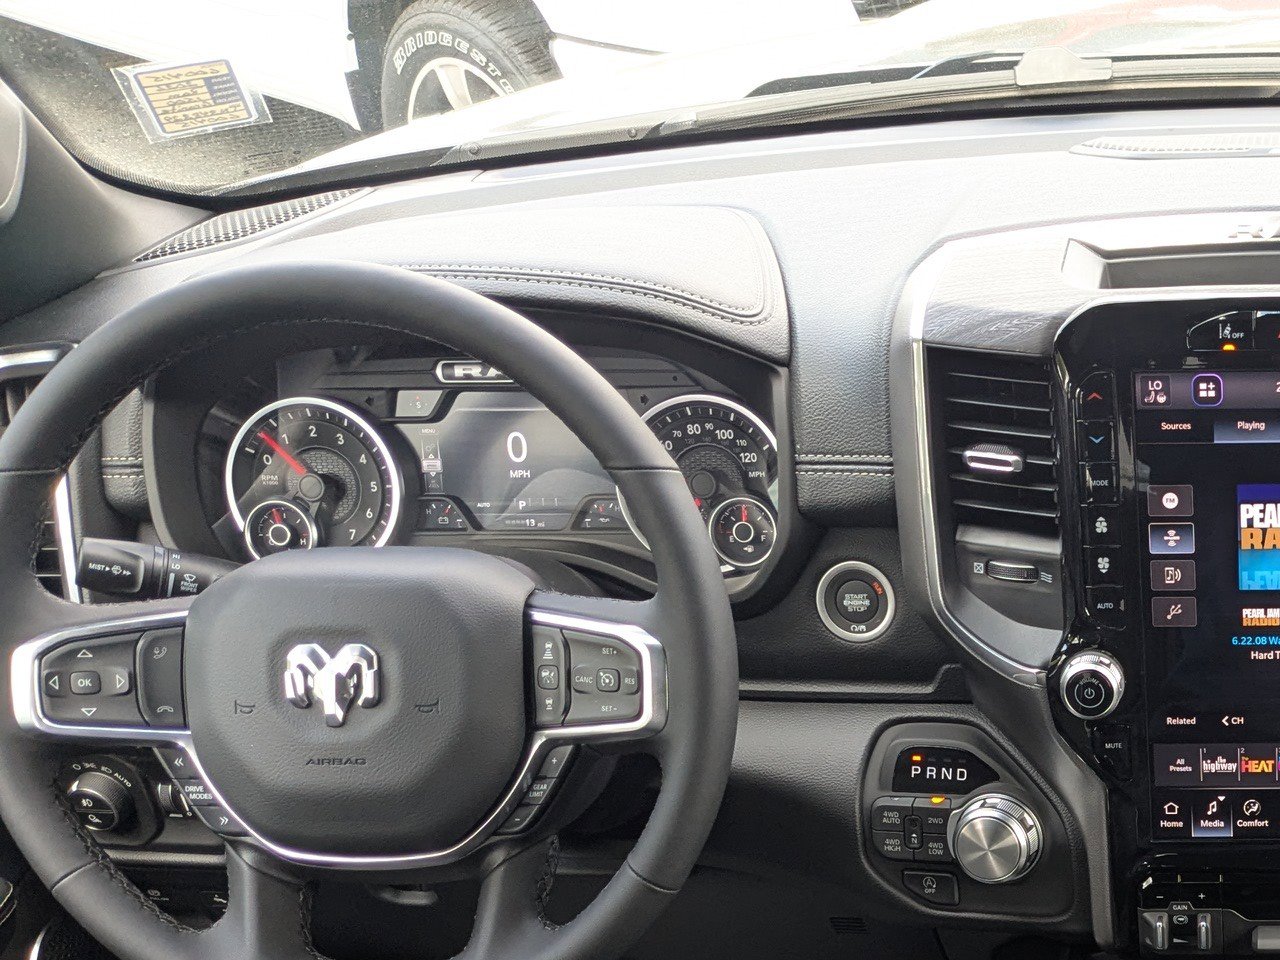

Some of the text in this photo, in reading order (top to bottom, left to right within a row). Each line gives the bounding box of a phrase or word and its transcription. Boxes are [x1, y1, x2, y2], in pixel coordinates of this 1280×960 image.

[1148, 380, 1163, 390] LO
[686, 423, 702, 436] 80
[704, 423, 714, 431] 90
[1160, 421, 1192, 431] Sources
[1236, 420, 1266, 432] Playing
[308, 425, 318, 438] 2
[672, 430, 683, 438] 70
[715, 429, 734, 440] 100
[281, 433, 290, 445] 1
[335, 433, 345, 445] 3
[736, 439, 748, 447] 110
[506, 431, 528, 463] 0
[263, 454, 272, 466] 0
[359, 453, 367, 465] 4
[739, 452, 758, 463] 120
[261, 474, 279, 482] RPM
[509, 469, 531, 479] MPH
[370, 481, 378, 492] 5
[1091, 479, 1110, 487] MODE
[518, 500, 527, 510] P
[365, 508, 373, 519] 6
[349, 529, 356, 540] 7
[729, 535, 735, 543] E
[761, 534, 767, 542] F
[300, 538, 307, 546] H
[88, 562, 106, 572] MIST
[171, 563, 181, 571] LO
[1096, 602, 1114, 610] AUTO
[1242, 607, 1280, 619] PEARL JAM
[1242, 618, 1280, 627] RADIO
[1231, 636, 1268, 646] 6.22.08
[1250, 650, 1274, 661] Hard
[77, 677, 93, 688] OK
[574, 675, 594, 685] CANC
[624, 676, 636, 685] RES
[1166, 716, 1197, 726] Related
[1230, 716, 1245, 725] CH
[305, 757, 367, 766] AIRBAG
[1202, 760, 1237, 773] highway
[1241, 759, 1275, 773] HEAT
[911, 765, 968, 781] P R N D
[113, 771, 132, 788] AUTO
[184, 785, 205, 793] DRIVE
[532, 783, 548, 791] GEAR
[189, 792, 213, 800] MODES
[529, 790, 545, 798] LIMIT
[882, 810, 900, 819] 4WD
[882, 817, 901, 825] AUTO
[927, 817, 944, 825] 2WD
[1160, 819, 1184, 828] Home
[1200, 819, 1225, 828] Media
[1236, 819, 1269, 828] Comfort
[911, 837, 918, 845] N
[927, 842, 944, 850] 4WD
[928, 848, 944, 856] LOW
